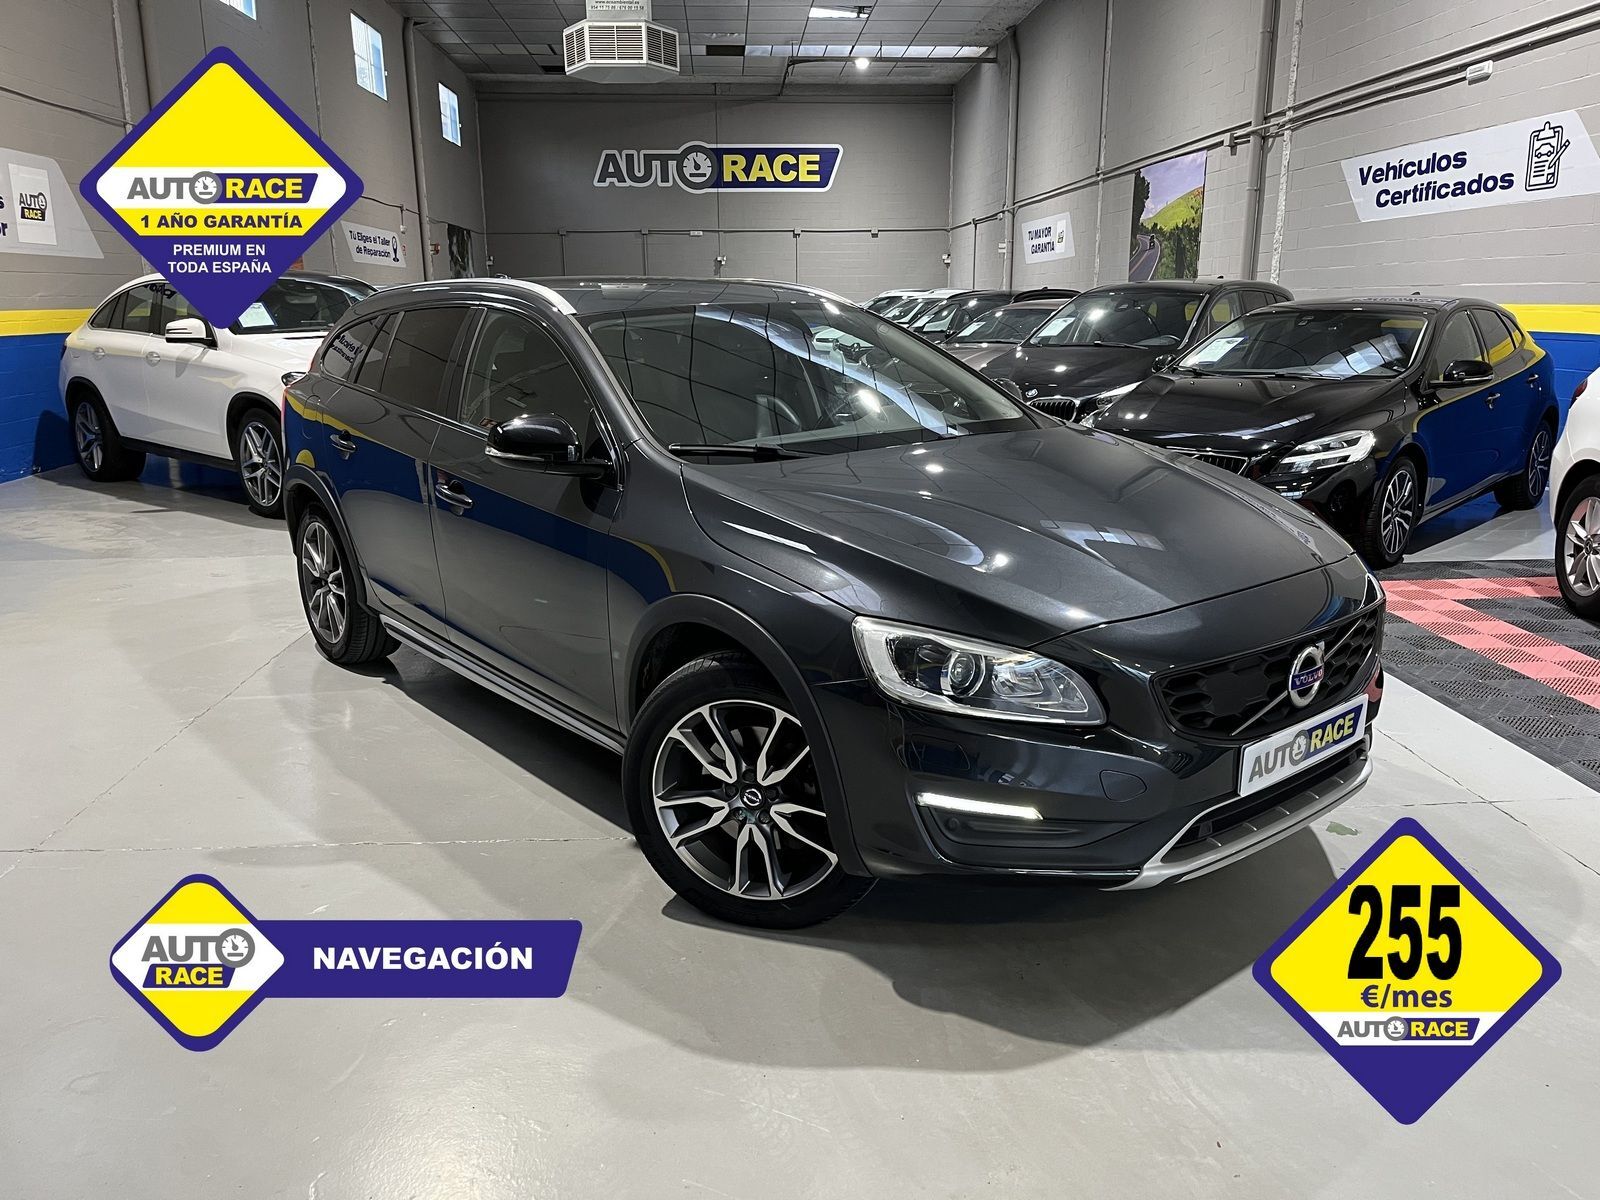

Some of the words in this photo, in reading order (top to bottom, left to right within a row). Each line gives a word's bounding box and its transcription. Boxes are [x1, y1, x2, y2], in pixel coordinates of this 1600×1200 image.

[722, 154, 821, 182] RACE
[1359, 151, 1468, 186] Vehículos
[1376, 172, 1515, 208] Certificados
[23, 208, 43, 220] RACE
[355, 245, 363, 255] de
[1294, 667, 1323, 686] VOLVO
[1310, 712, 1355, 752] RACE
